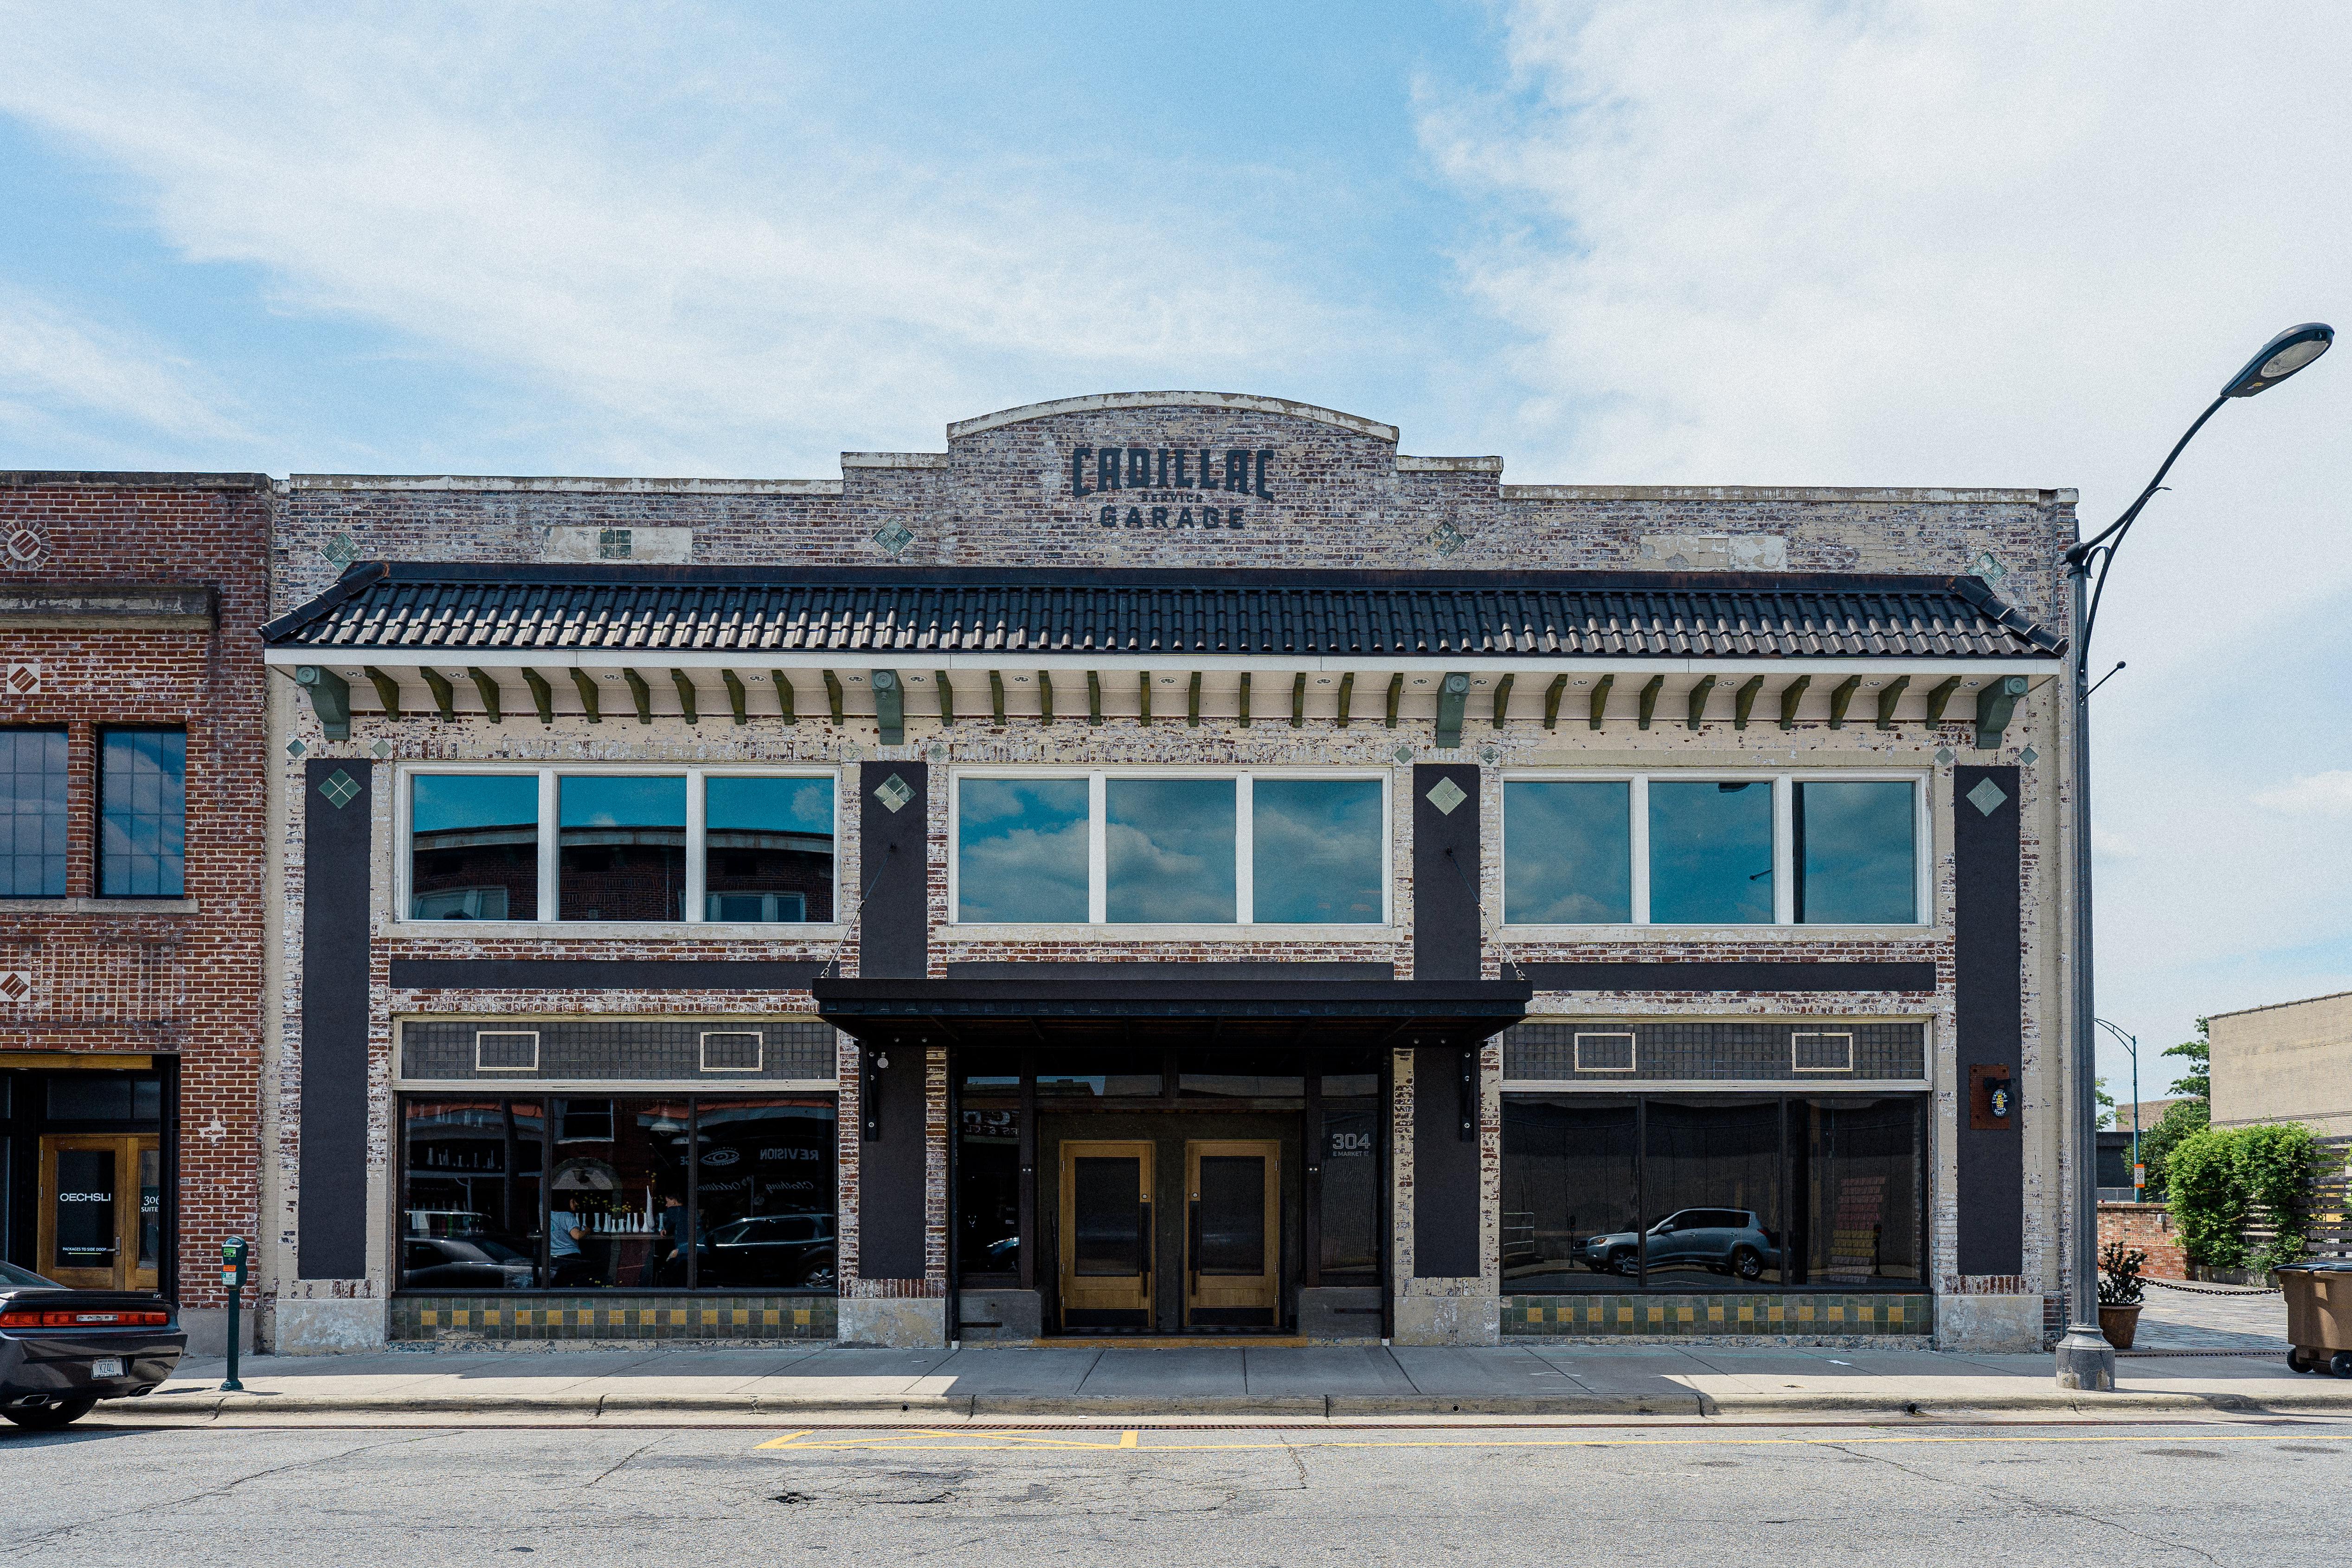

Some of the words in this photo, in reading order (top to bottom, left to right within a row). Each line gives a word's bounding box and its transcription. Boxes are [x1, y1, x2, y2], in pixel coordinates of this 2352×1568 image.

[1073, 448, 1274, 501] CADILLAC
[1141, 493, 1203, 503] SERVICE
[1100, 506, 1244, 528] GARAGE
[1992, 1090, 2007, 1100] CADILLAC
[1332, 1133, 1371, 1149] 304
[60, 1193, 111, 1202] OECHSLI
